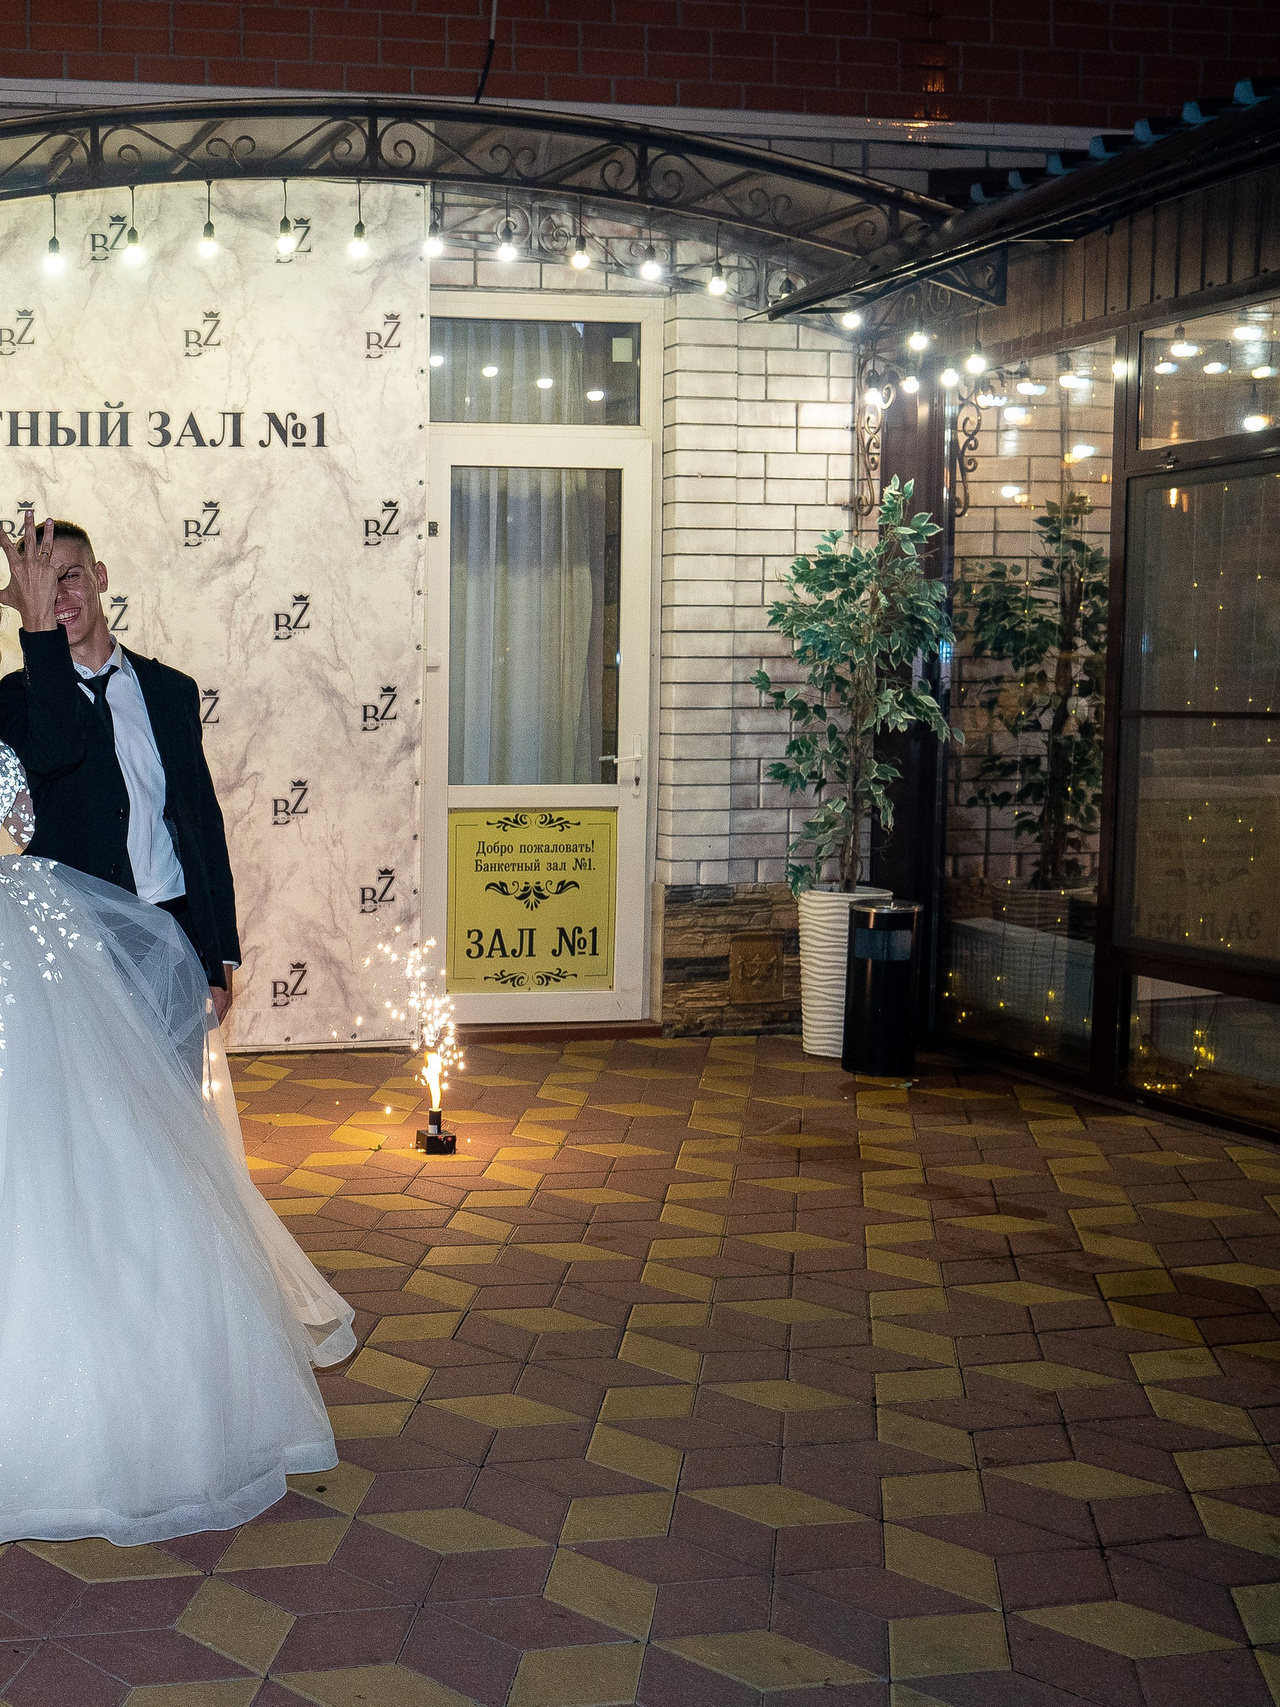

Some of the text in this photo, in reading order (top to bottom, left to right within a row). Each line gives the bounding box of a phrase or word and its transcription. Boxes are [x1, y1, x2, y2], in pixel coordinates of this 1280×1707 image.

[147, 411, 245, 447] ЗАЛ
[258, 411, 329, 448] №1
[476, 840, 595, 857] Добро пожаловать!
[474, 858, 596, 872] Банкетный зал №1.
[465, 926, 599, 959] ЗАЛ №1
